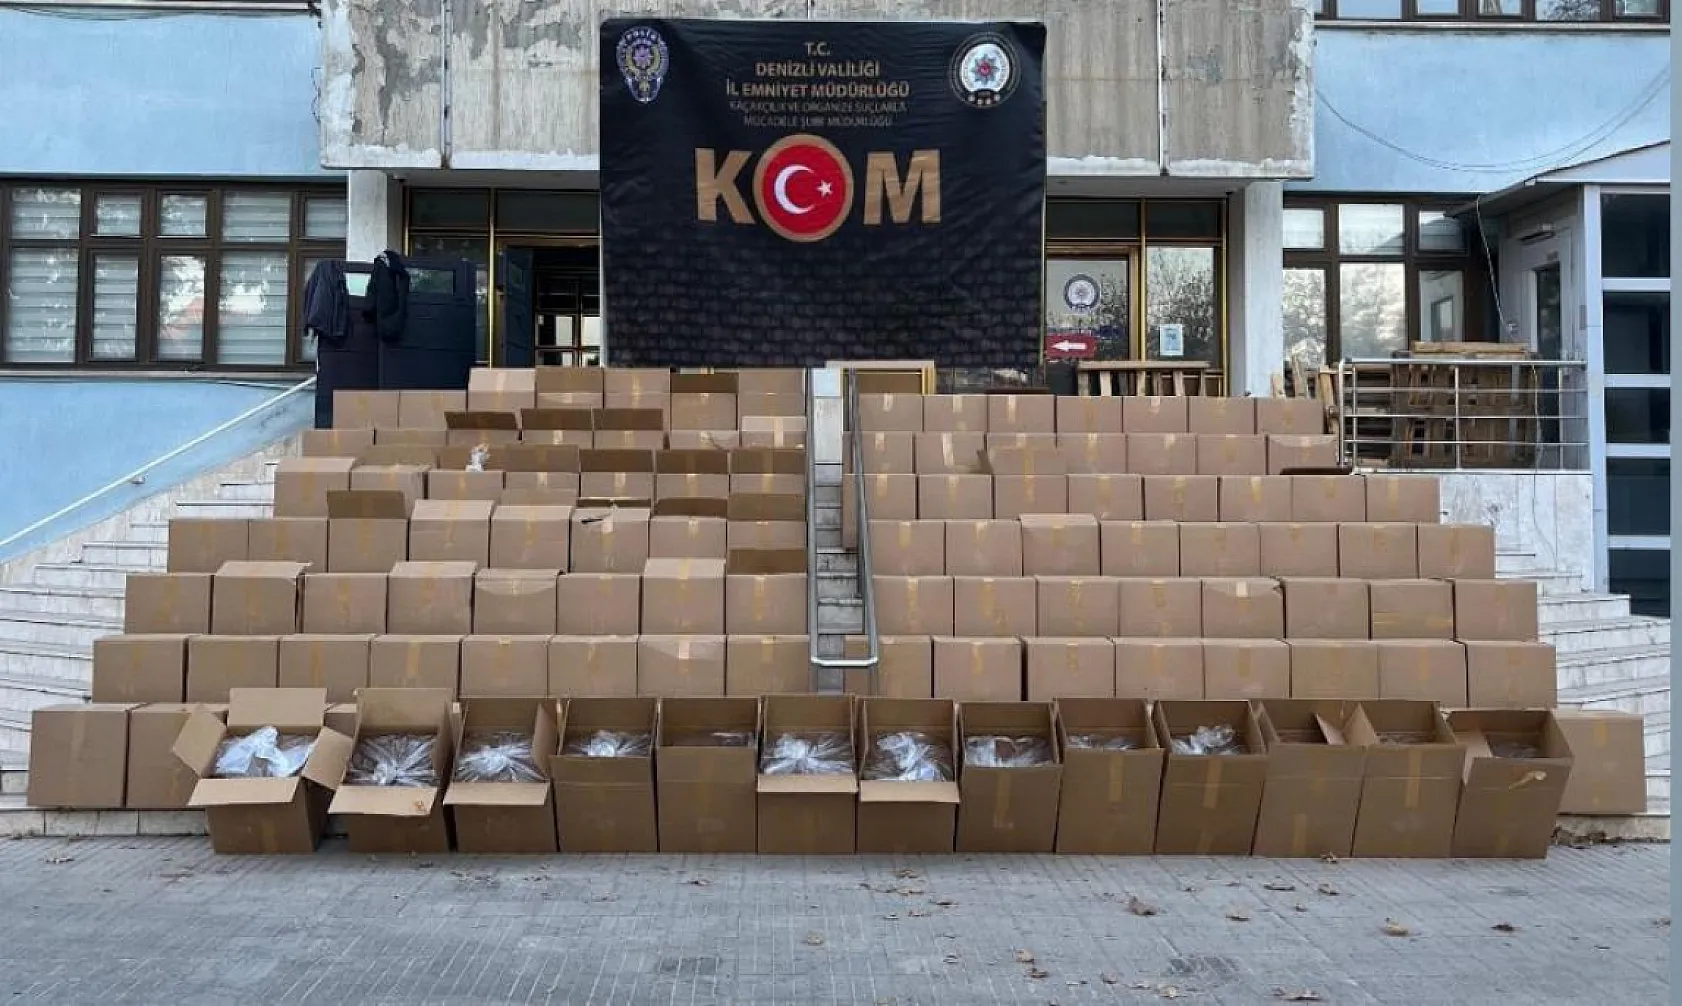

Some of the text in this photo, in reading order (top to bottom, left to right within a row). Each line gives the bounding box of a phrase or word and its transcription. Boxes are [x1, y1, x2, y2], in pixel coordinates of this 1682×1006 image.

[804, 41, 831, 56] T.C.
[755, 60, 880, 77] DENİZLİ VALİLİĞİ
[726, 79, 910, 98] İL EMNİYET MÜDÜRLÜĞÜ
